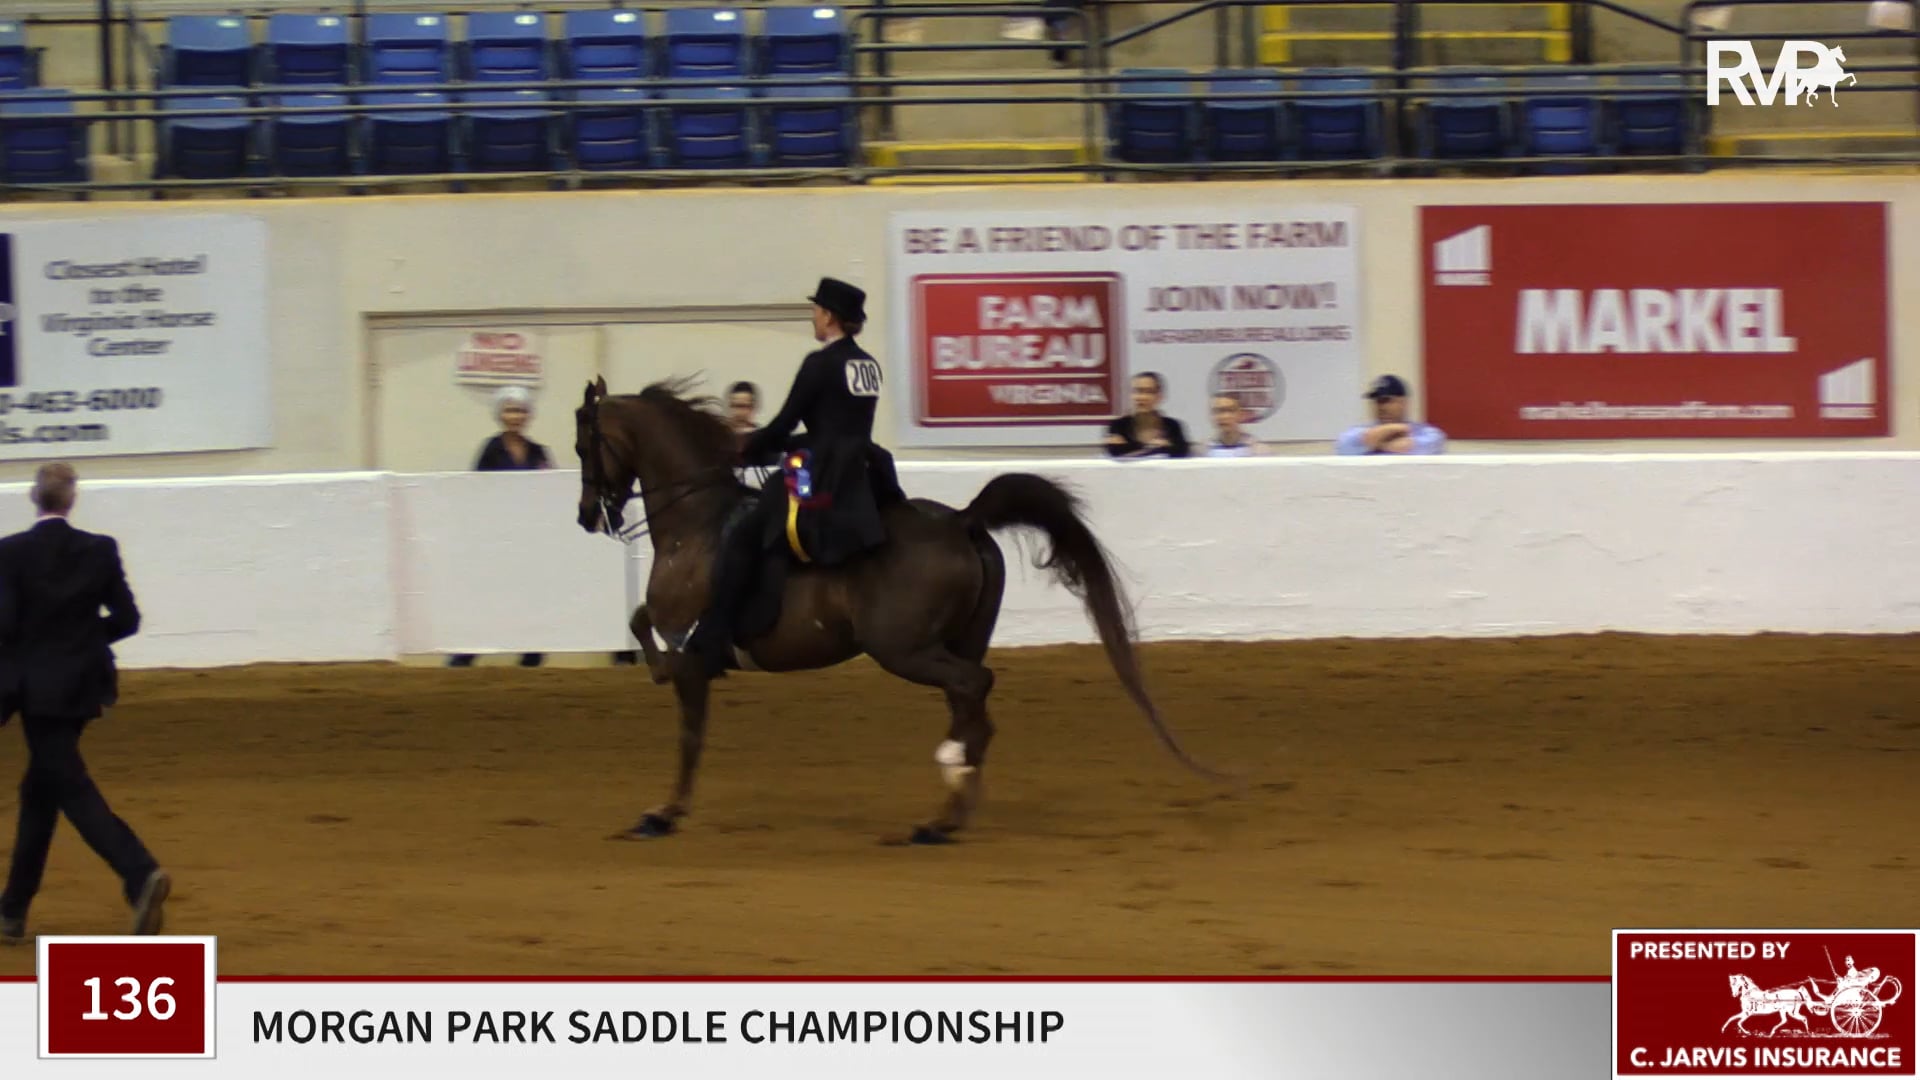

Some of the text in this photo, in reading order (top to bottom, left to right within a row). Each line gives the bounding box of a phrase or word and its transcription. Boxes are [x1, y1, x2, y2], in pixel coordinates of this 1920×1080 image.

[904, 221, 1346, 254] BE A FRIEND OF THE FARM
[119, 283, 164, 303] the
[1145, 282, 1337, 312] JOIN NOW!
[978, 295, 1102, 330] FARM
[1516, 288, 1797, 353] MARKEL
[87, 337, 173, 356] Center
[932, 334, 1105, 369] BUREAU
[848, 362, 879, 392] 208
